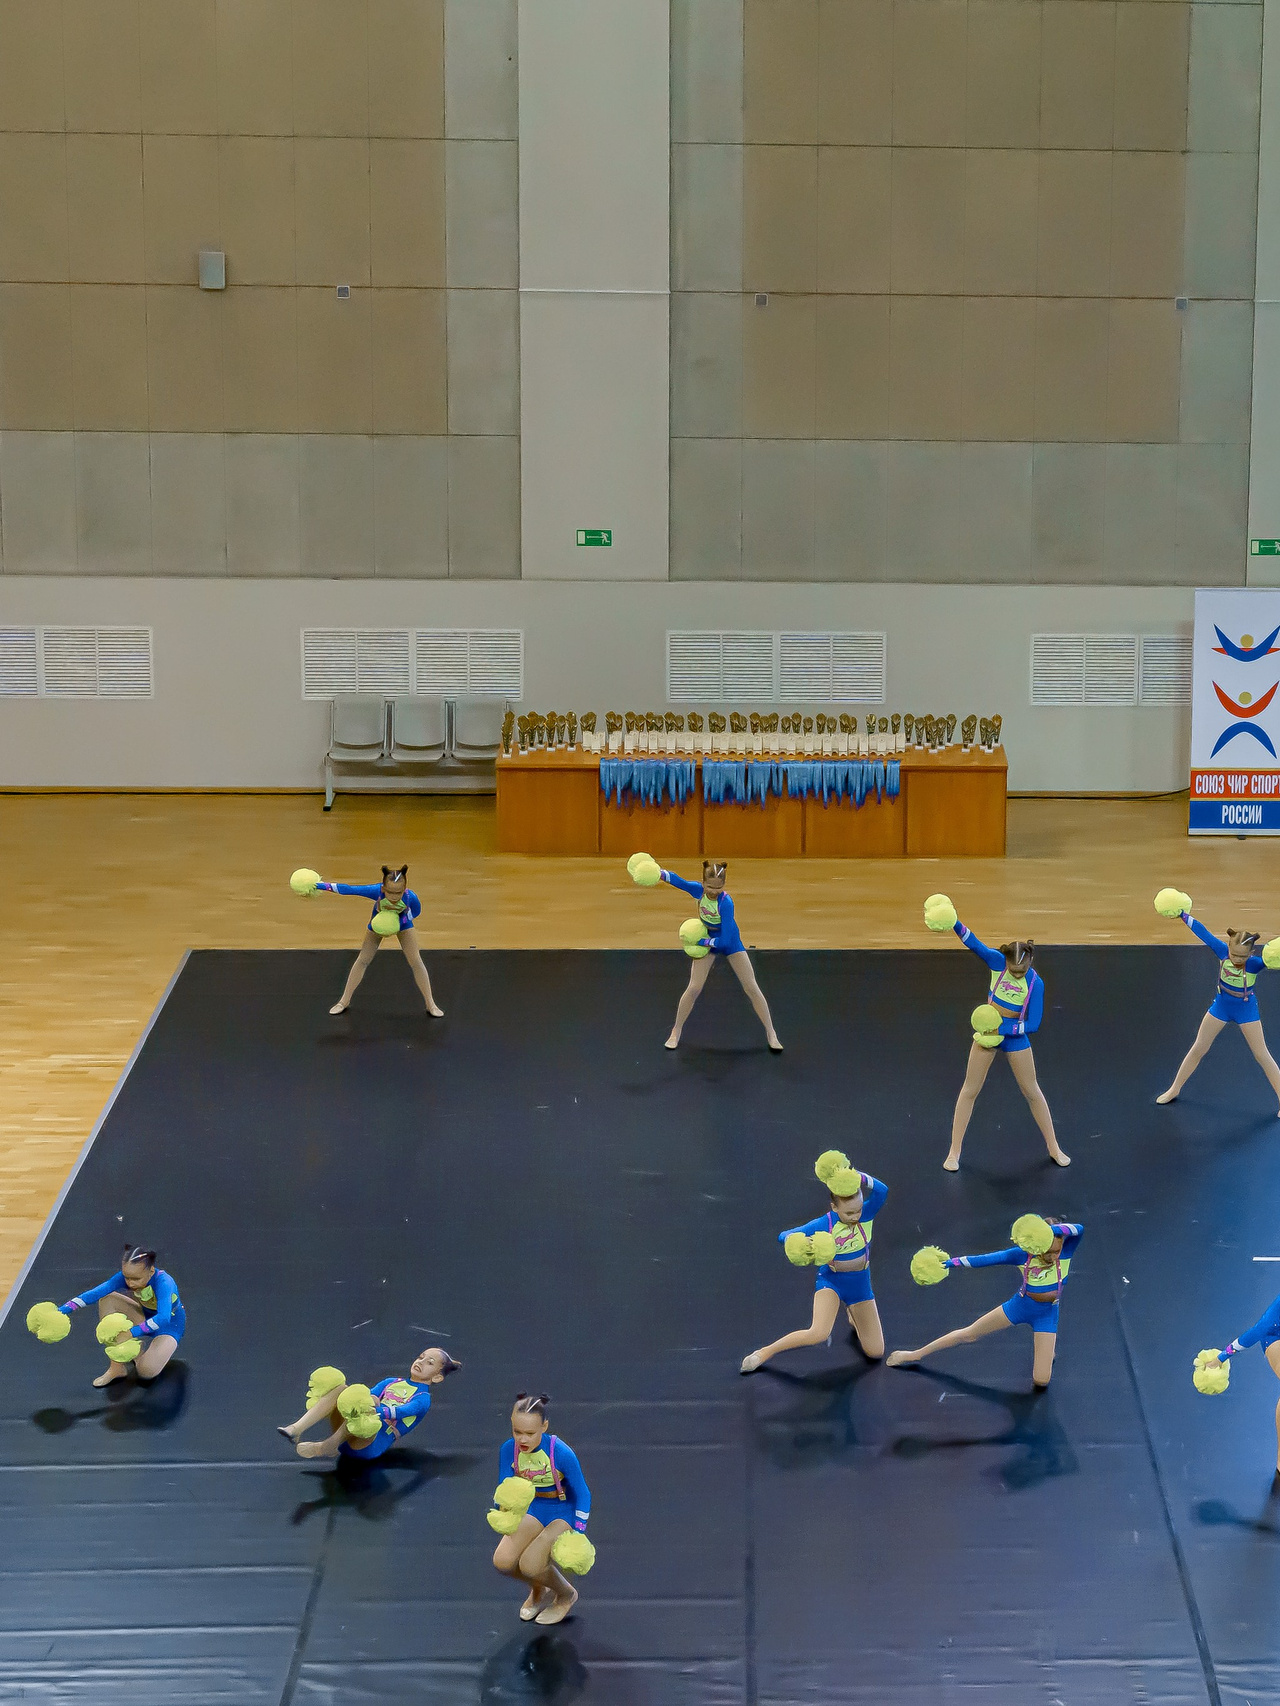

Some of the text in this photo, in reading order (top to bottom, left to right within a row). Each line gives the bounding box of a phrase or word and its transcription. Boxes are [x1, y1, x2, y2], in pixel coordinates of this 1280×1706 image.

[1195, 775, 1225, 794] СОЮЗ
[1227, 775, 1248, 794] ЧИР
[1221, 805, 1262, 825] РОССИИ
